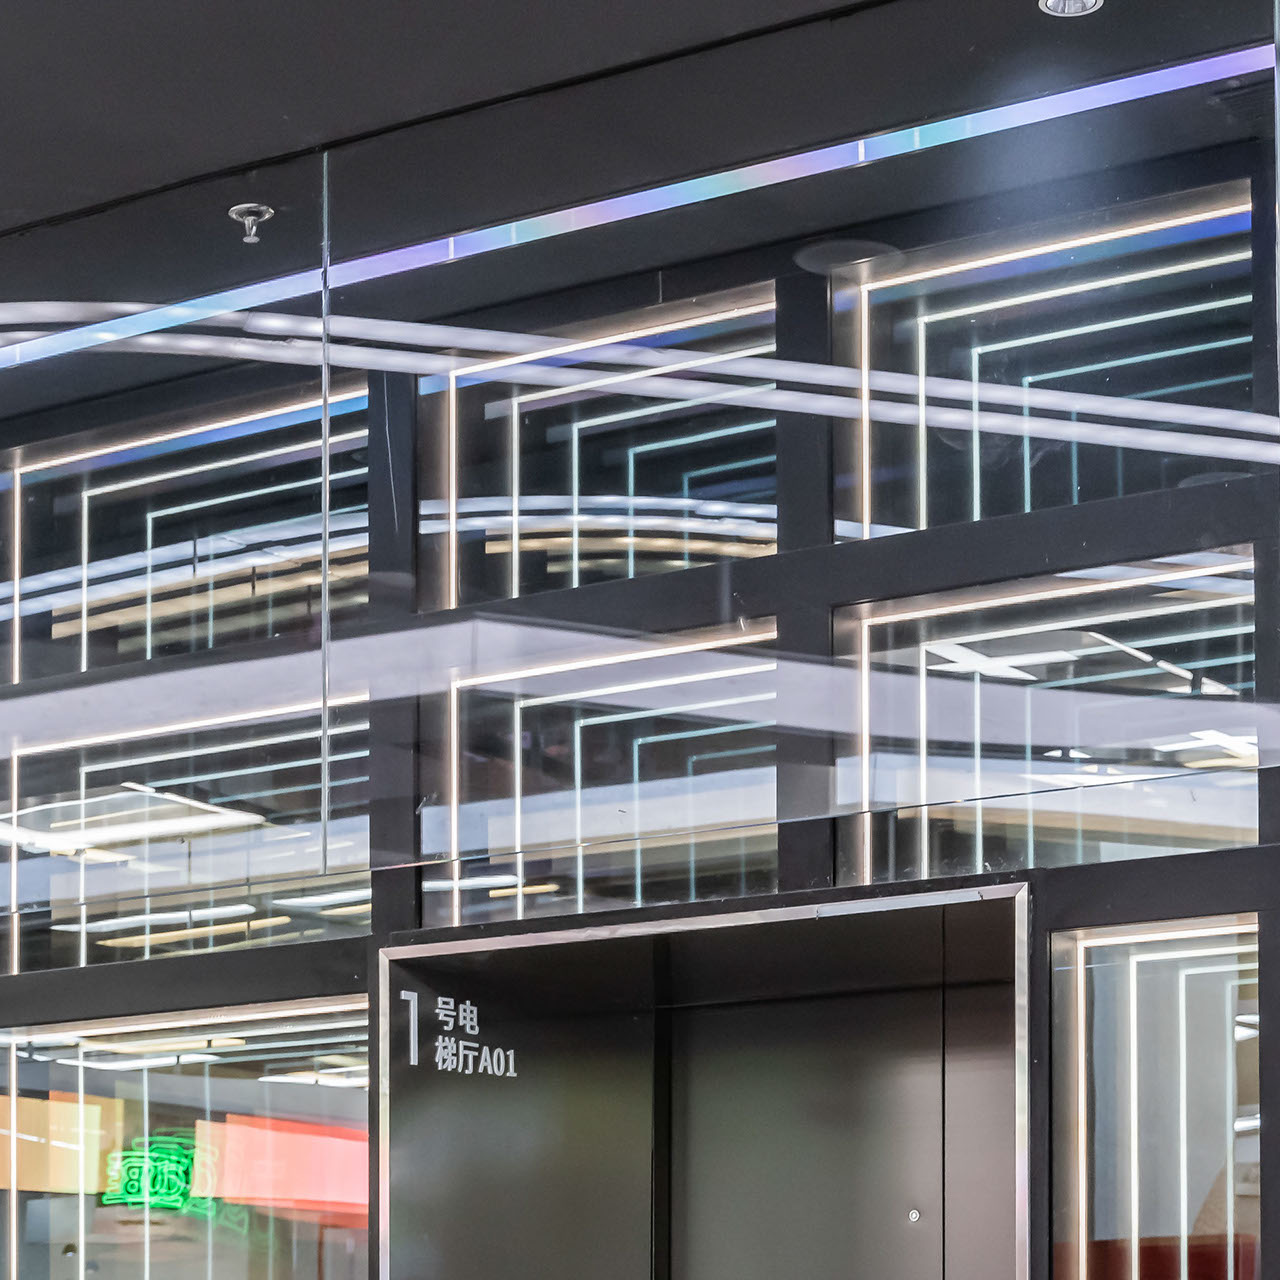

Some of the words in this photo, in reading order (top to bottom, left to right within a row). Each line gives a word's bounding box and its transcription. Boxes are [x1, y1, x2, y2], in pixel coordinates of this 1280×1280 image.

[400, 990, 419, 1066] 1
[434, 996, 480, 1035] 号电
[434, 1035, 518, 1077] 梯厅A01
